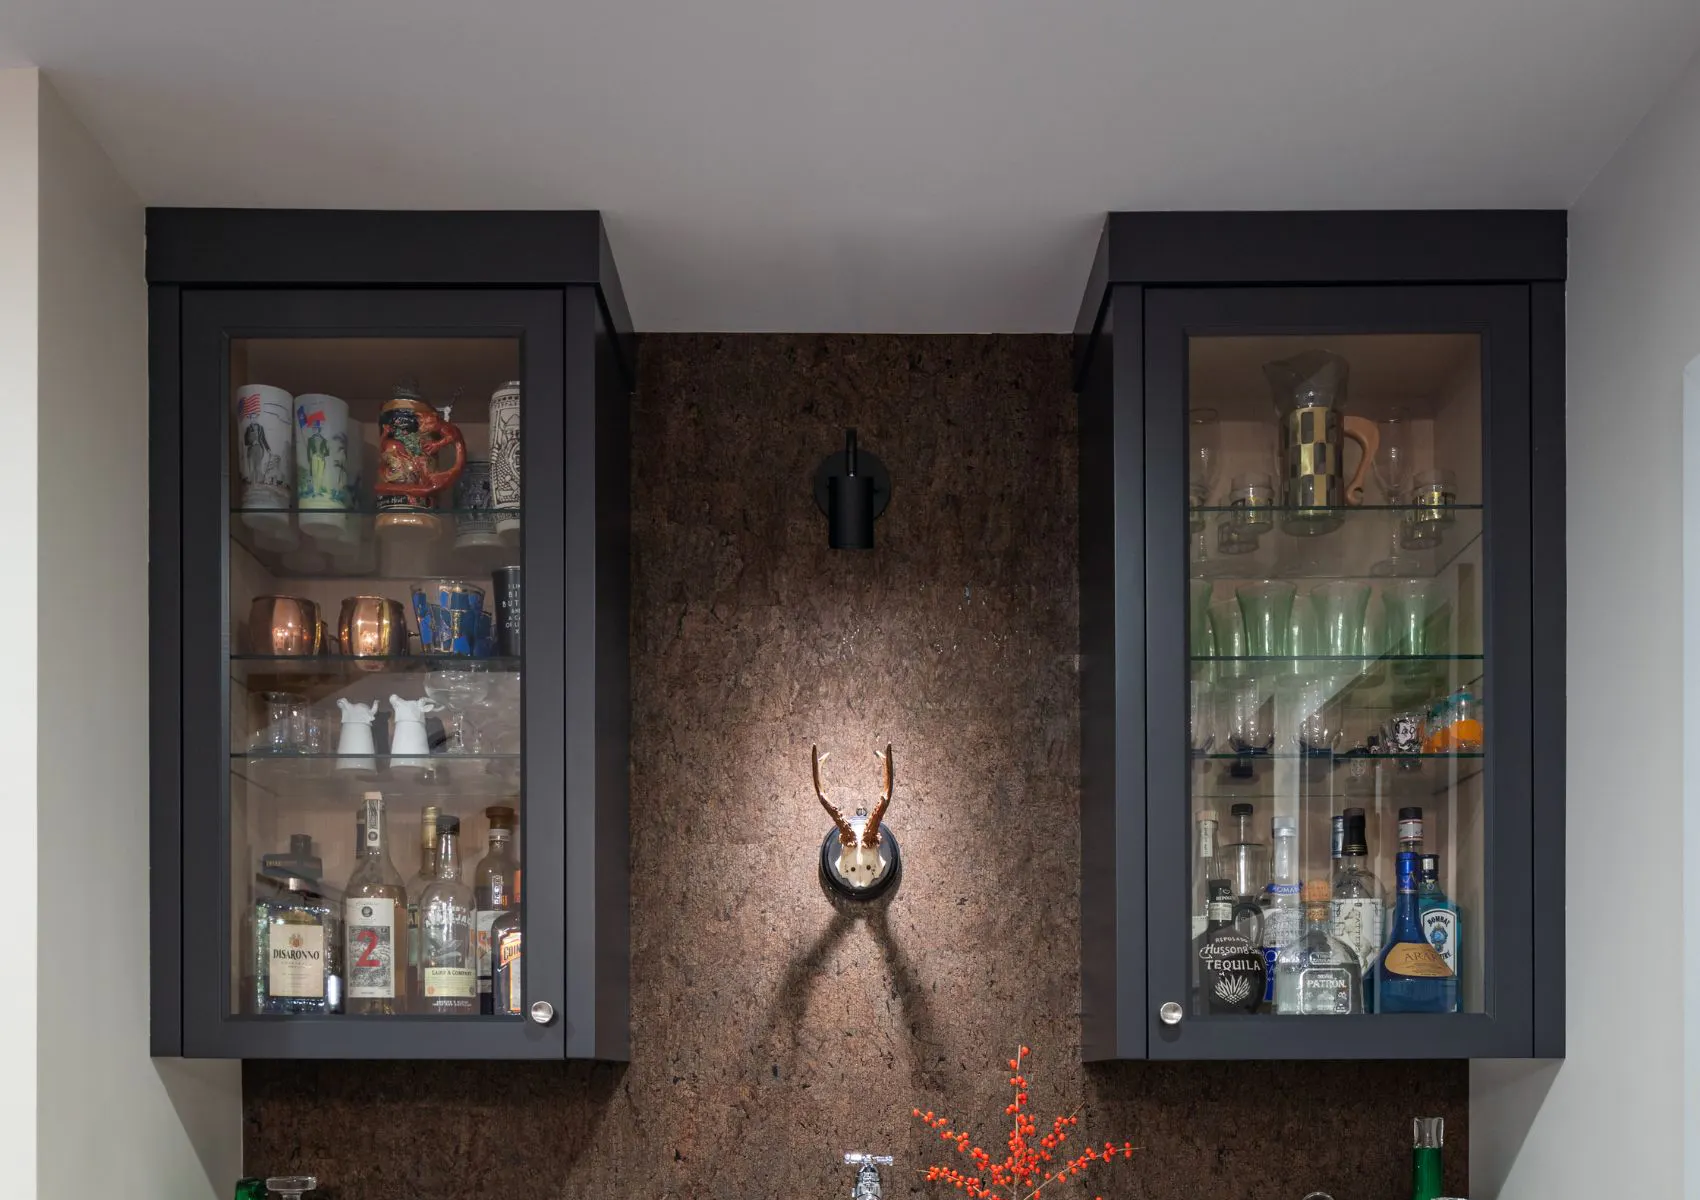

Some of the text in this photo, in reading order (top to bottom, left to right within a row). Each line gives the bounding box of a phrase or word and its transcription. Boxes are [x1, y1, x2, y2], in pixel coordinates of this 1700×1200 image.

[355, 928, 381, 968] 2
[273, 949, 320, 960] DISARONNO
[1205, 959, 1261, 971] TEQUILA
